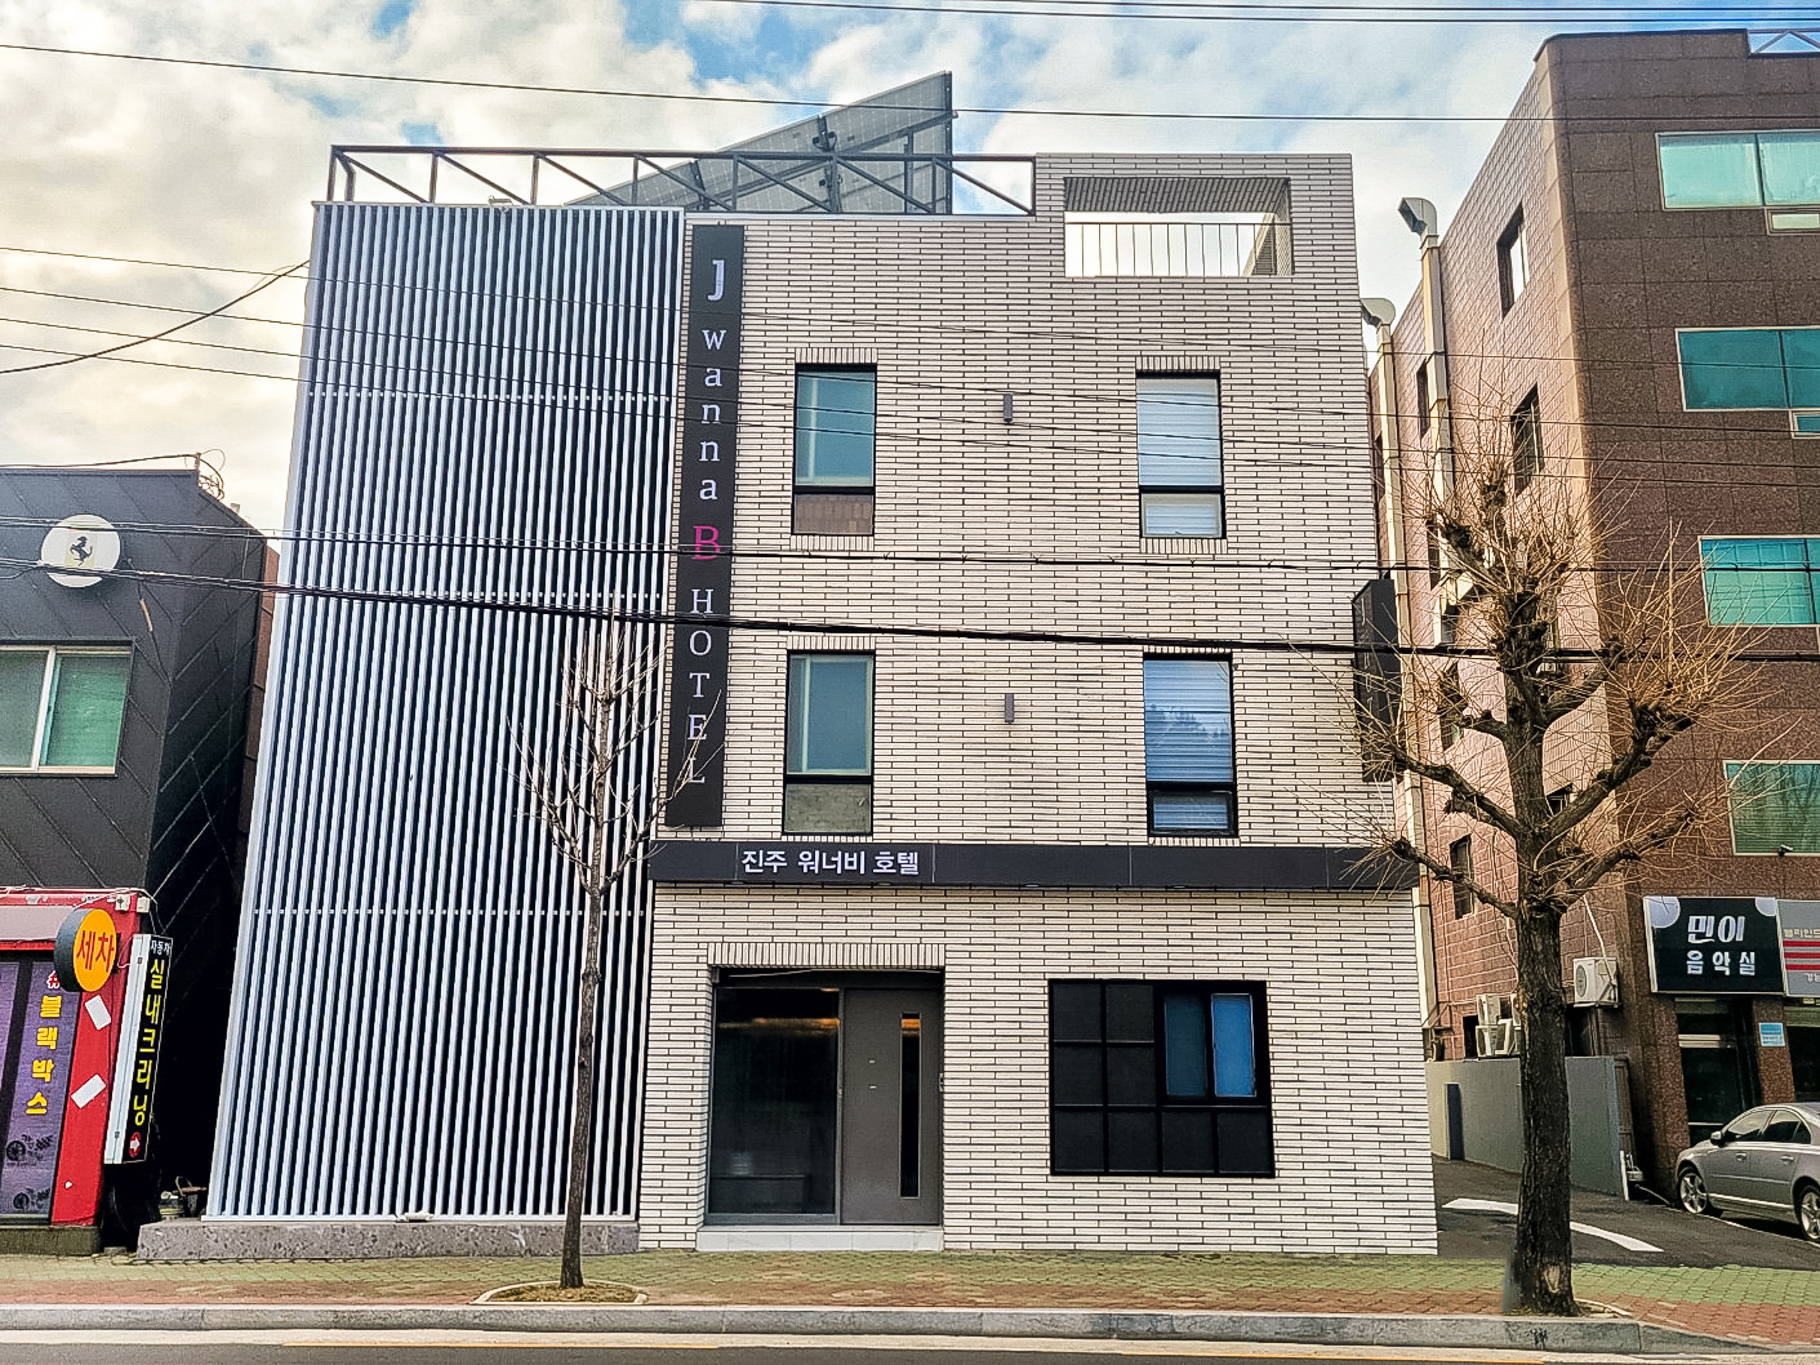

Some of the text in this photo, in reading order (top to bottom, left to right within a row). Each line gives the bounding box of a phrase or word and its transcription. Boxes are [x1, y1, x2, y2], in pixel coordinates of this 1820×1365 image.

[691, 524, 721, 561] B
[687, 588, 715, 784] HOTEL
[741, 849, 920, 876] 진주 워너비 호텔
[1688, 916, 1745, 943] 민이
[77, 930, 115, 971] 세차
[150, 939, 172, 956] 자동차
[1686, 950, 1756, 977] 음악실
[25, 995, 62, 1115] 블랙박스
